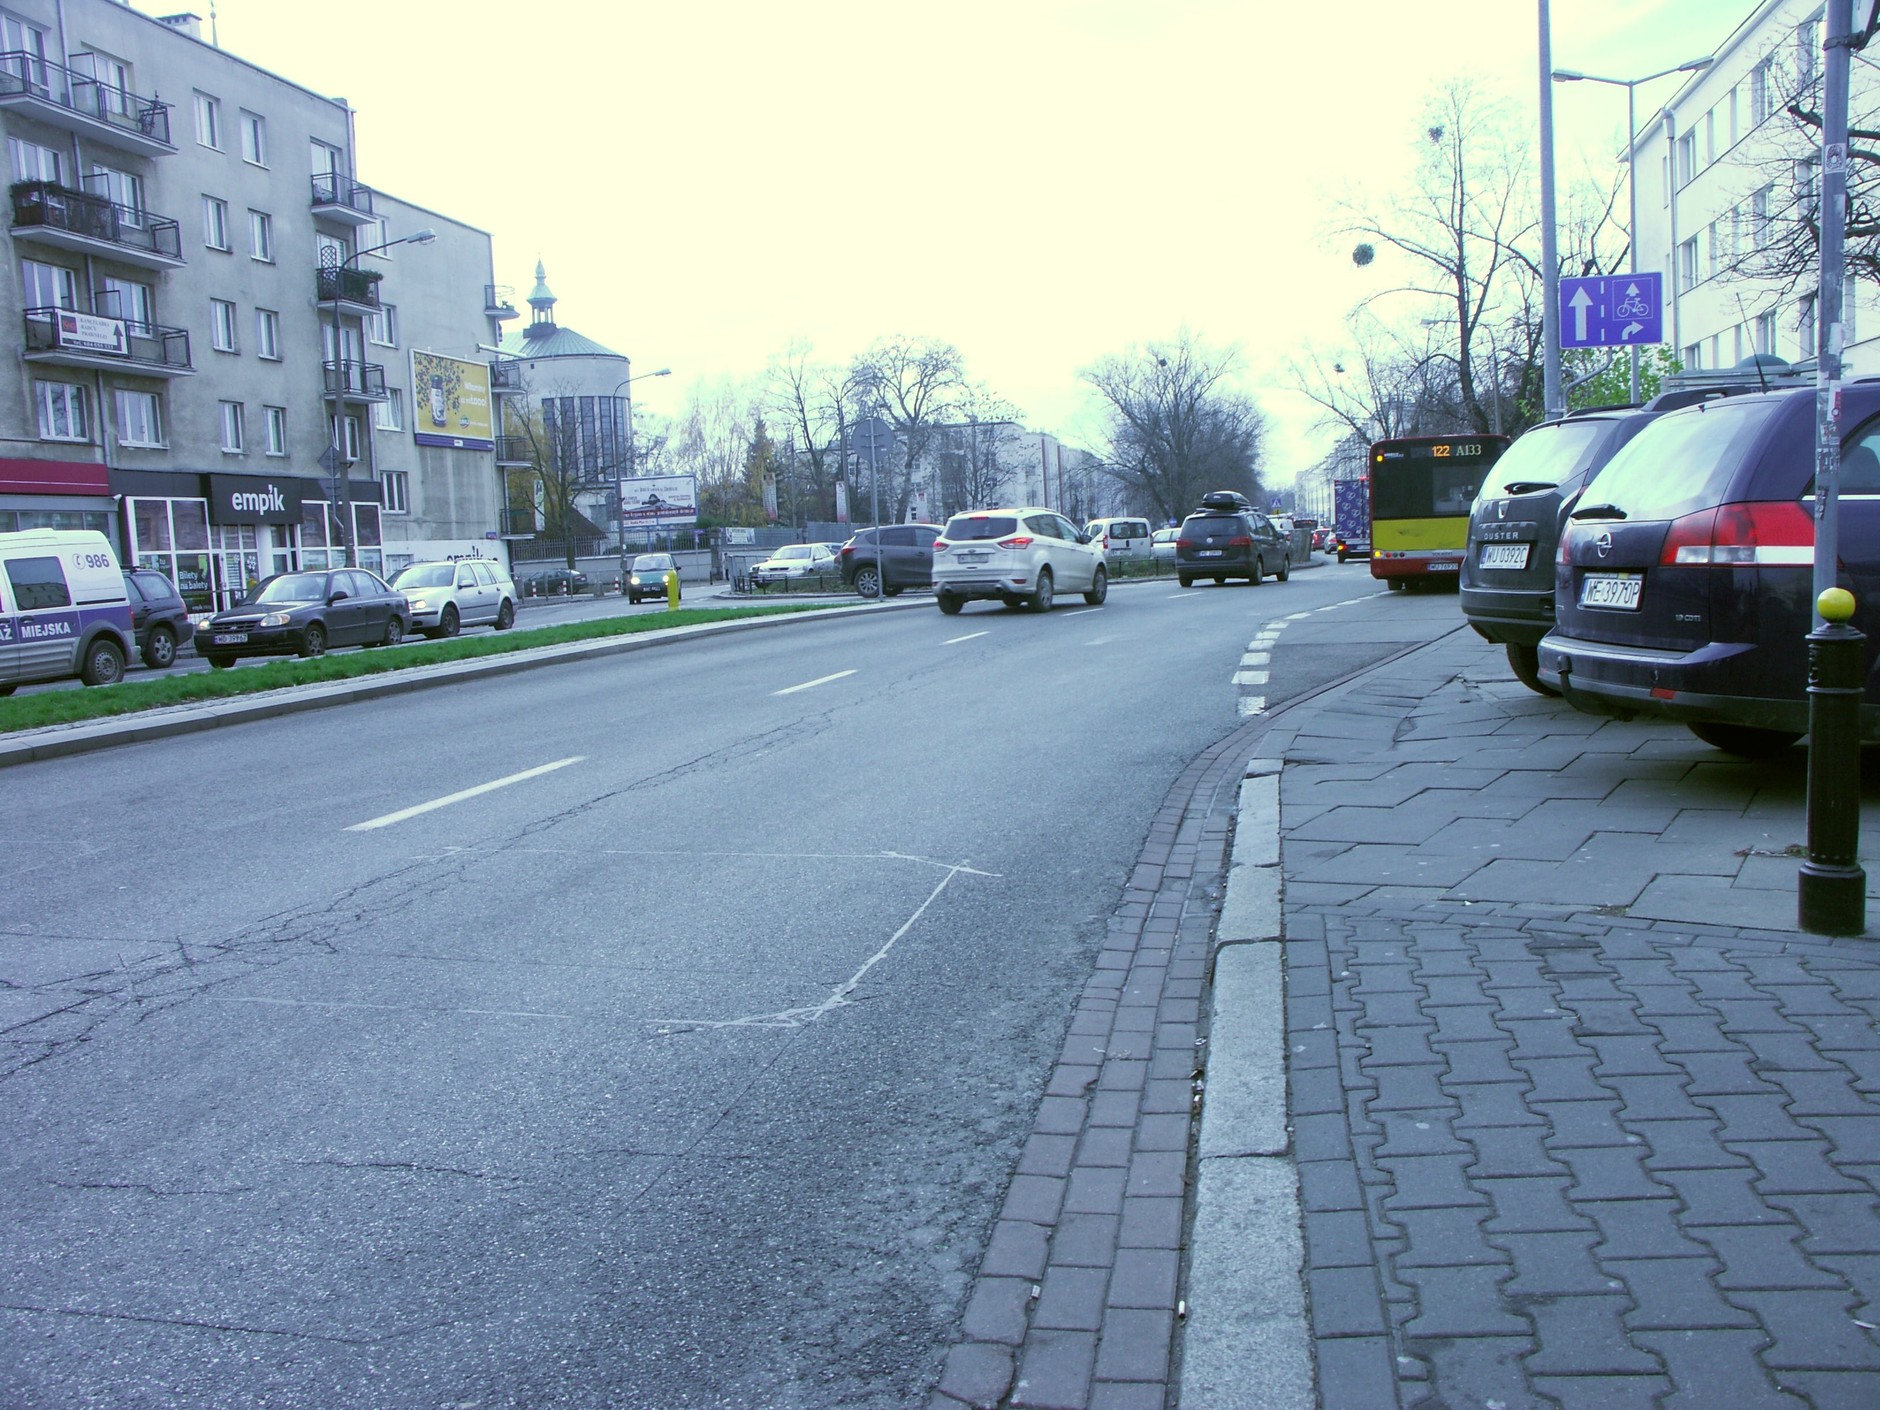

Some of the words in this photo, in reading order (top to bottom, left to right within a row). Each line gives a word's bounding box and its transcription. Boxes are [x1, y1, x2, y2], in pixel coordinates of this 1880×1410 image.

[1432, 445, 1450, 457] 122
[1456, 444, 1482, 456] A133
[232, 484, 285, 515] empik
[1483, 531, 1519, 540] DUSTER
[86, 554, 110, 568] 986
[179, 571, 198, 580] Bilety
[189, 581, 208, 590] balety
[21, 622, 71, 639] MIEJSKA
